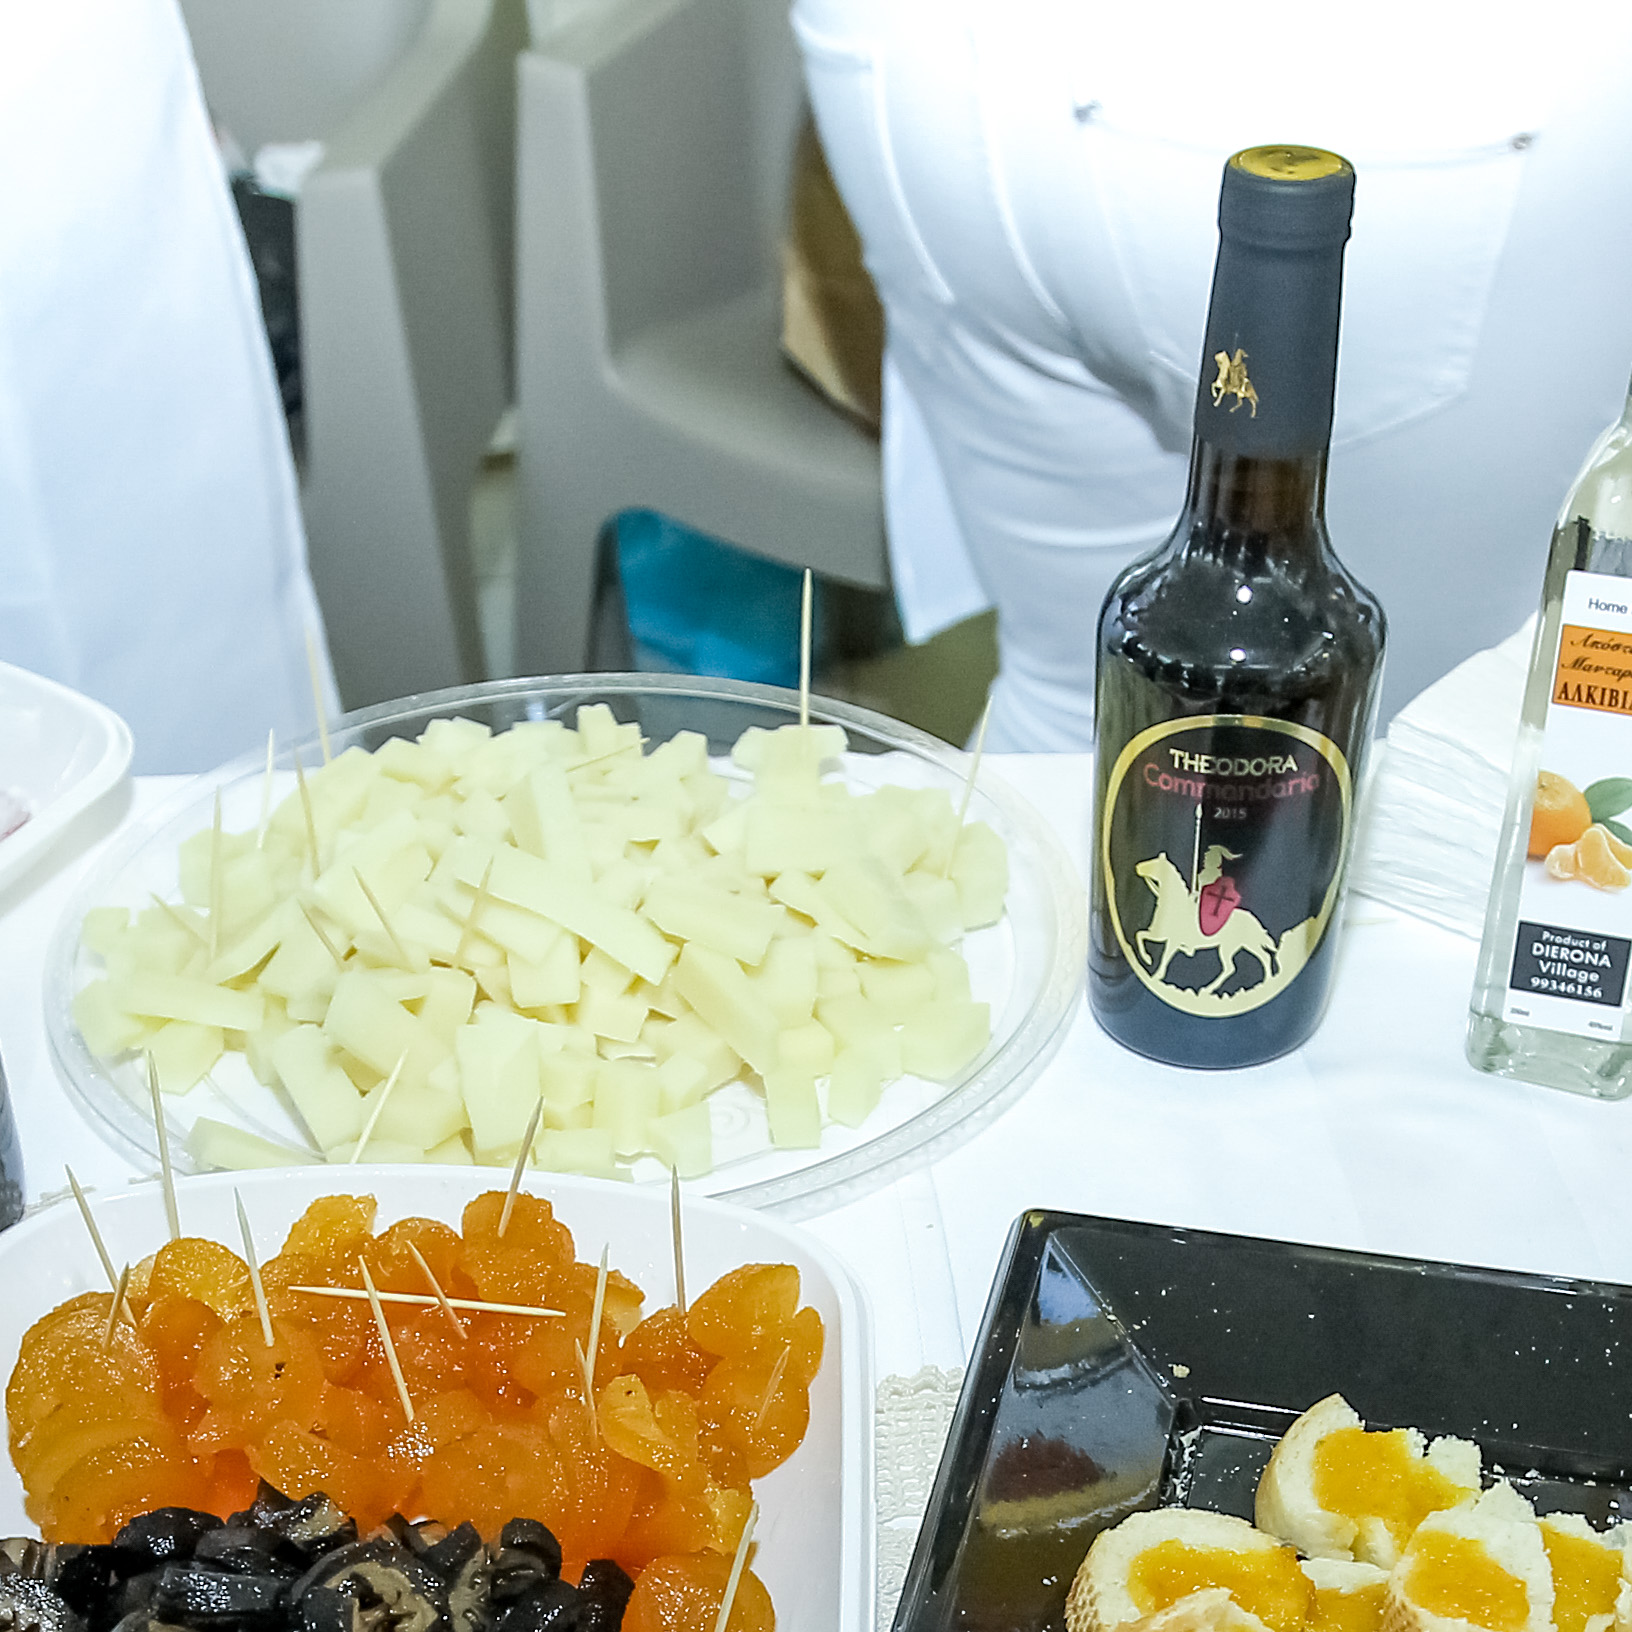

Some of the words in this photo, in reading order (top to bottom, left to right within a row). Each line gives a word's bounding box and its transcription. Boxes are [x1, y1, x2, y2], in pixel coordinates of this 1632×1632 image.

[1587, 597, 1628, 613] Home
[1169, 747, 1299, 776] THEODORA
[1213, 806, 1247, 820] 2015
[1542, 930, 1591, 948] Product
[1592, 940, 1608, 951] of
[1531, 942, 1612, 968] DIERONA
[1539, 960, 1600, 984] Village
